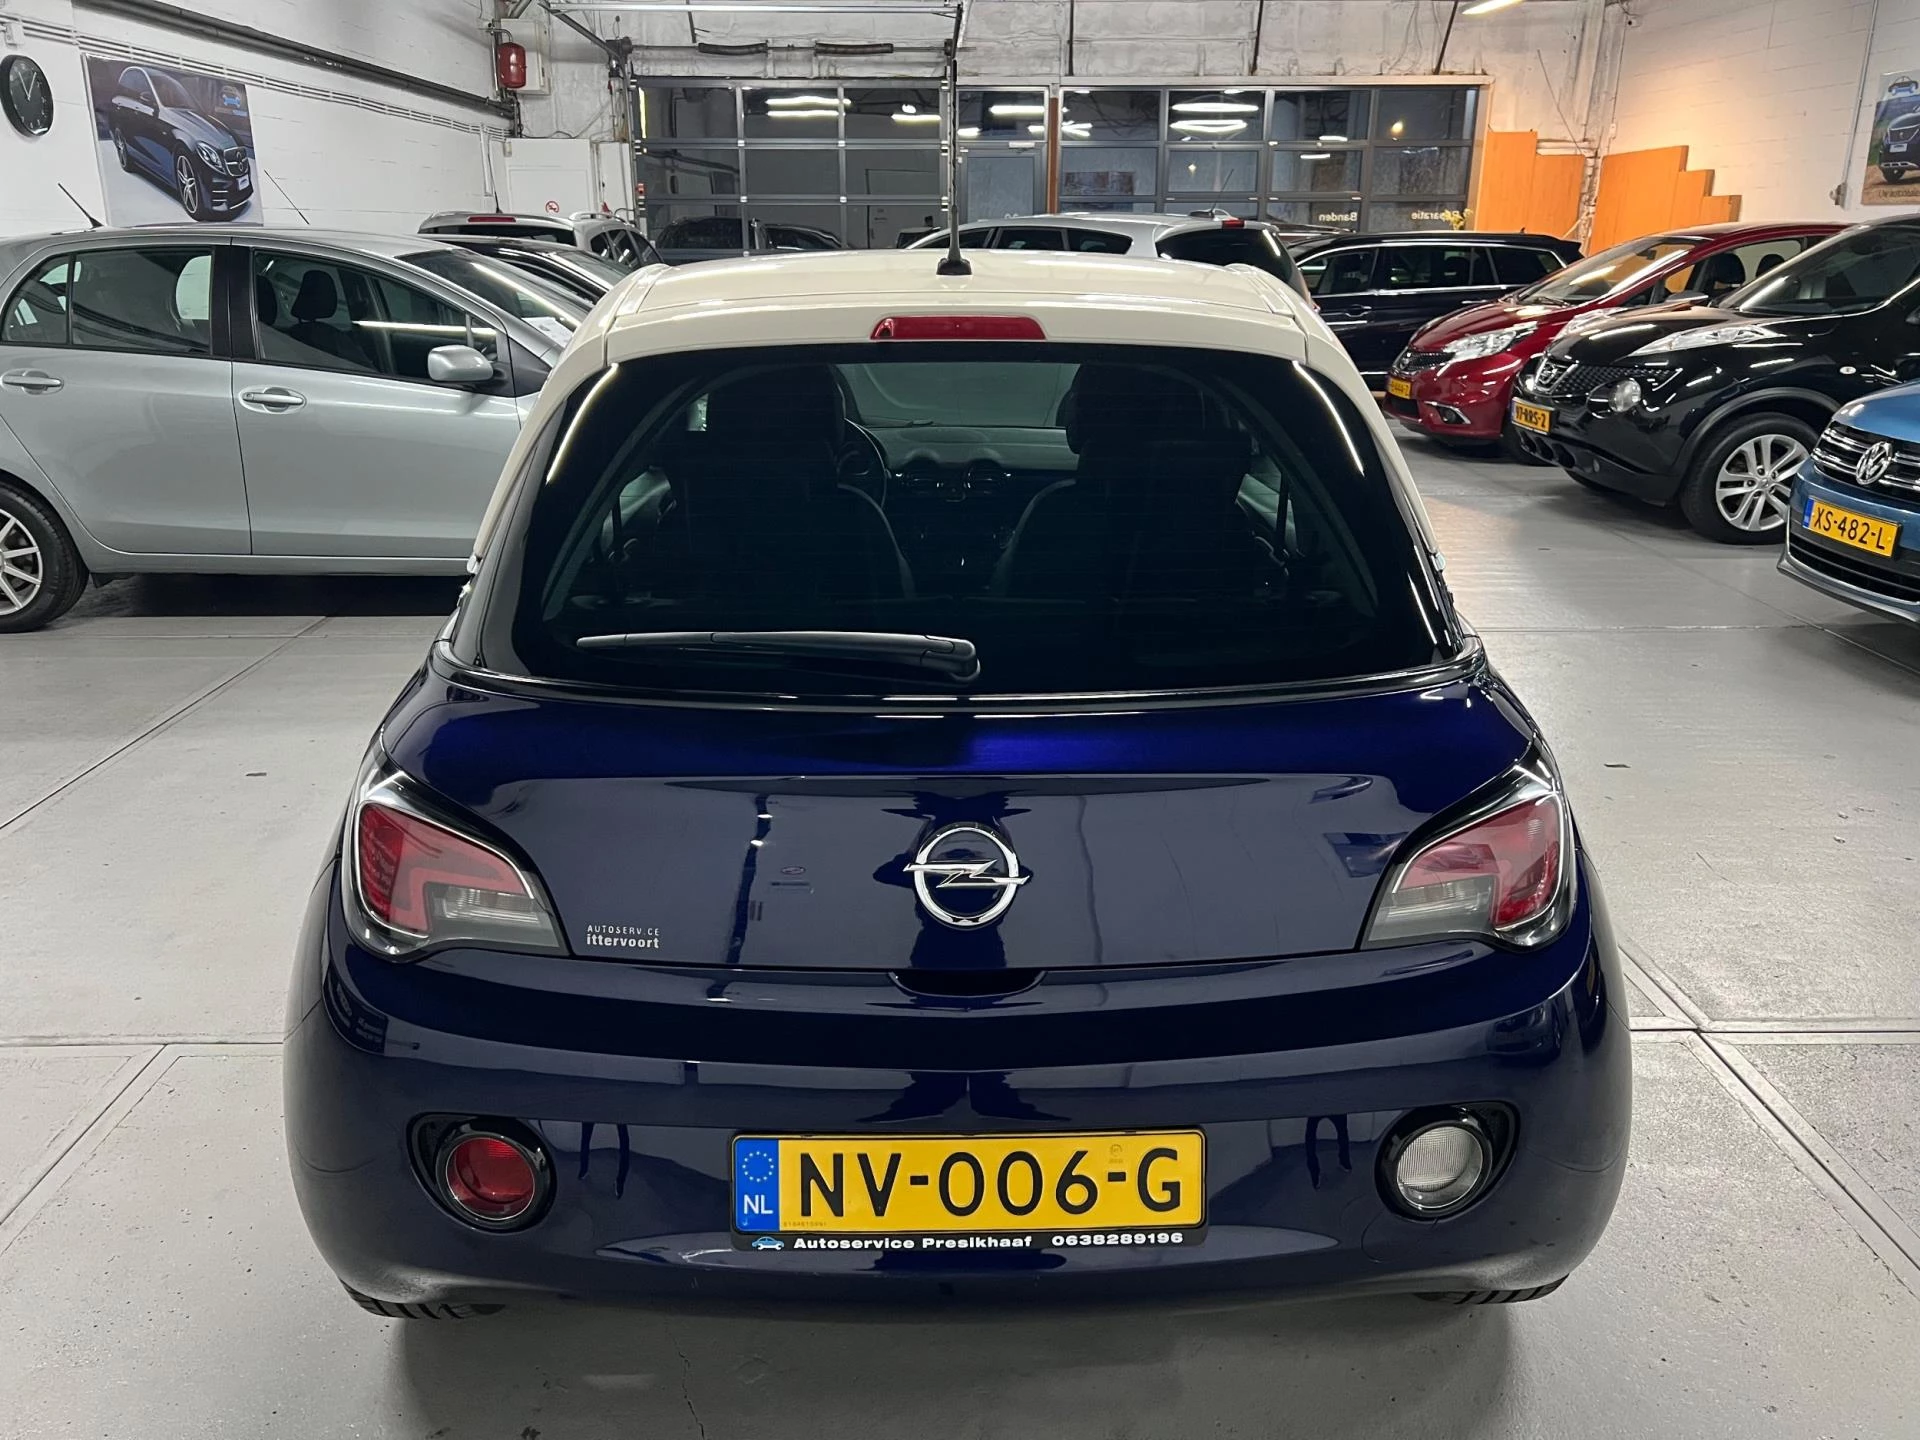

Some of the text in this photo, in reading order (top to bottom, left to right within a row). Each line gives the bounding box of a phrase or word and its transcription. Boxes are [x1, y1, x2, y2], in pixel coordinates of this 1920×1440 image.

[1813, 507, 1885, 550] XS-482-L
[587, 925, 659, 936] AUTOSERVCE
[587, 934, 659, 948] ittervoort
[800, 1147, 1181, 1217] NV-006-G
[743, 1194, 773, 1215] NL
[793, 1232, 1184, 1249] Autoservice Presikhaaf 0638289196
